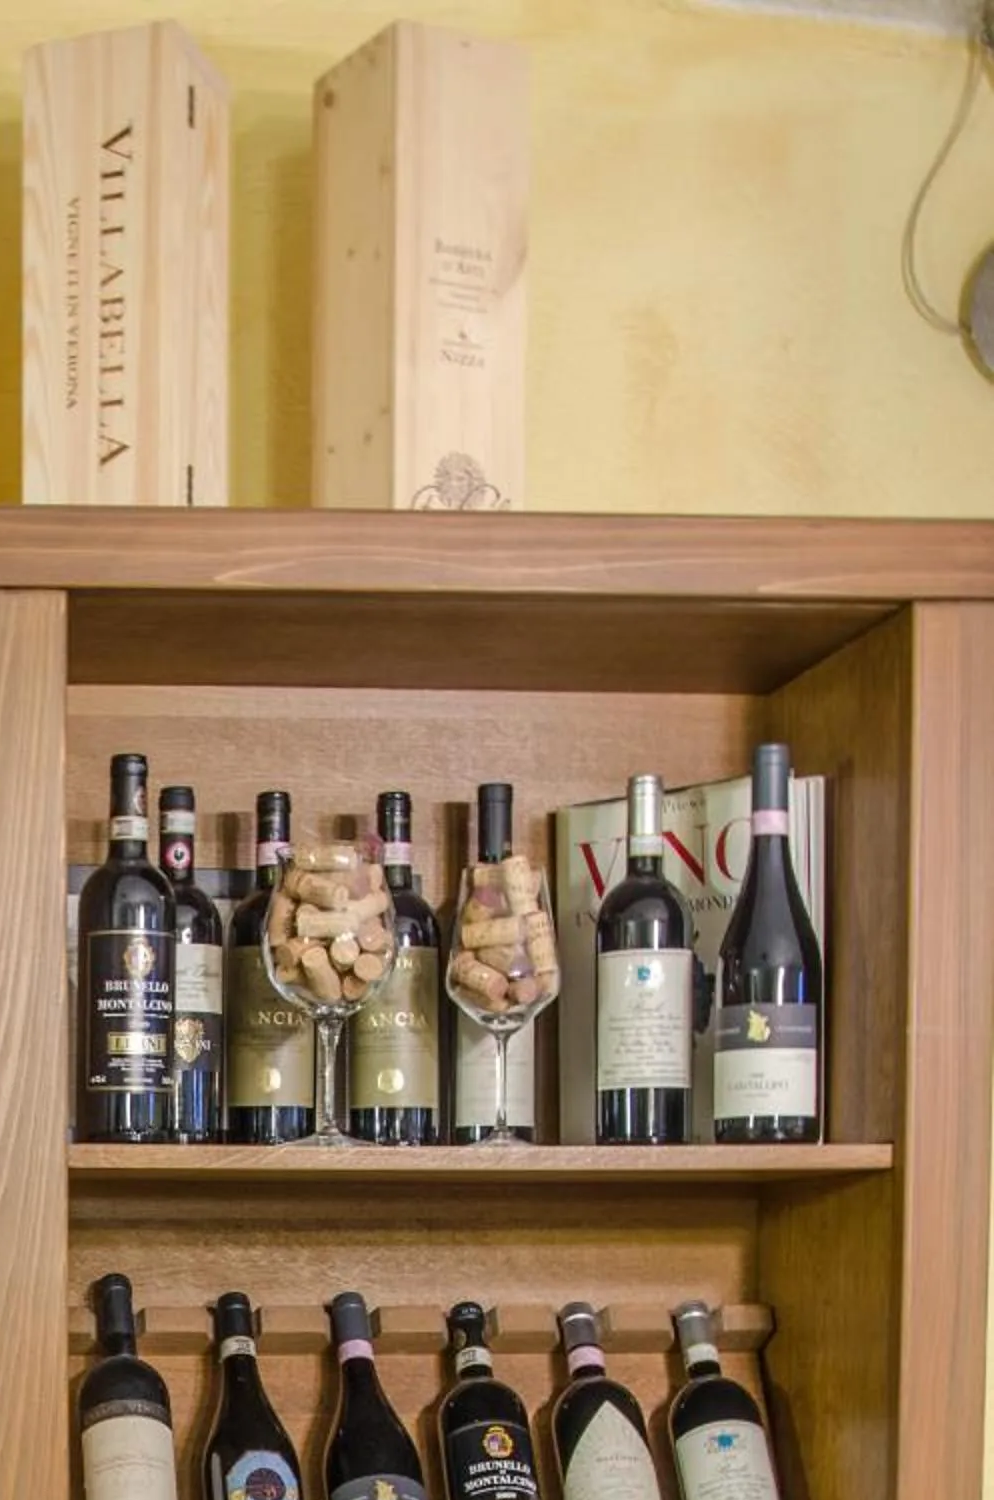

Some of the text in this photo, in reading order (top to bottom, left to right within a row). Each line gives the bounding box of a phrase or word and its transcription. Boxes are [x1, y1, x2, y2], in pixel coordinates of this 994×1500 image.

[64, 196, 81, 410] VIGNETI IN VERONA
[98, 123, 133, 468] VILLABELLA
[463, 1474, 538, 1493] MONTALCINO
[469, 1460, 532, 1476] BRUNELLO
